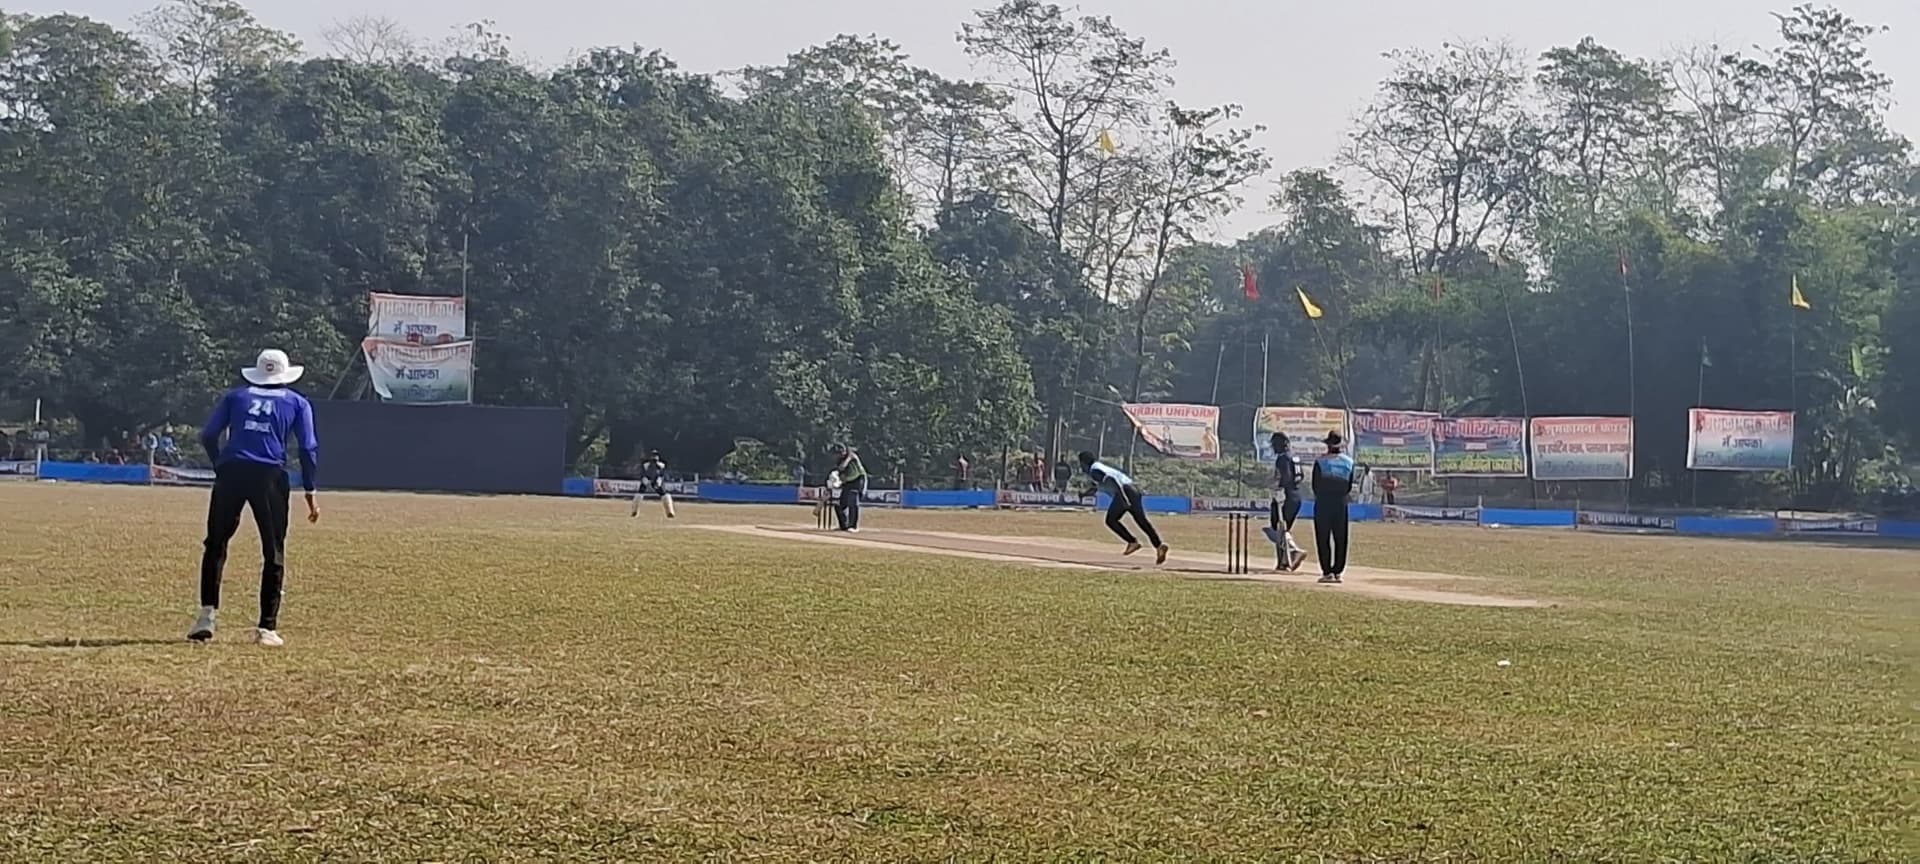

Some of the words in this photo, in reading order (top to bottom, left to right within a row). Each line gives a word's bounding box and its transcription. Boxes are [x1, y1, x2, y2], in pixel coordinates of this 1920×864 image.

[248, 400, 273, 416] 24
[1127, 406, 1163, 417] URBHI
[1165, 406, 1216, 417] UNIFORM
